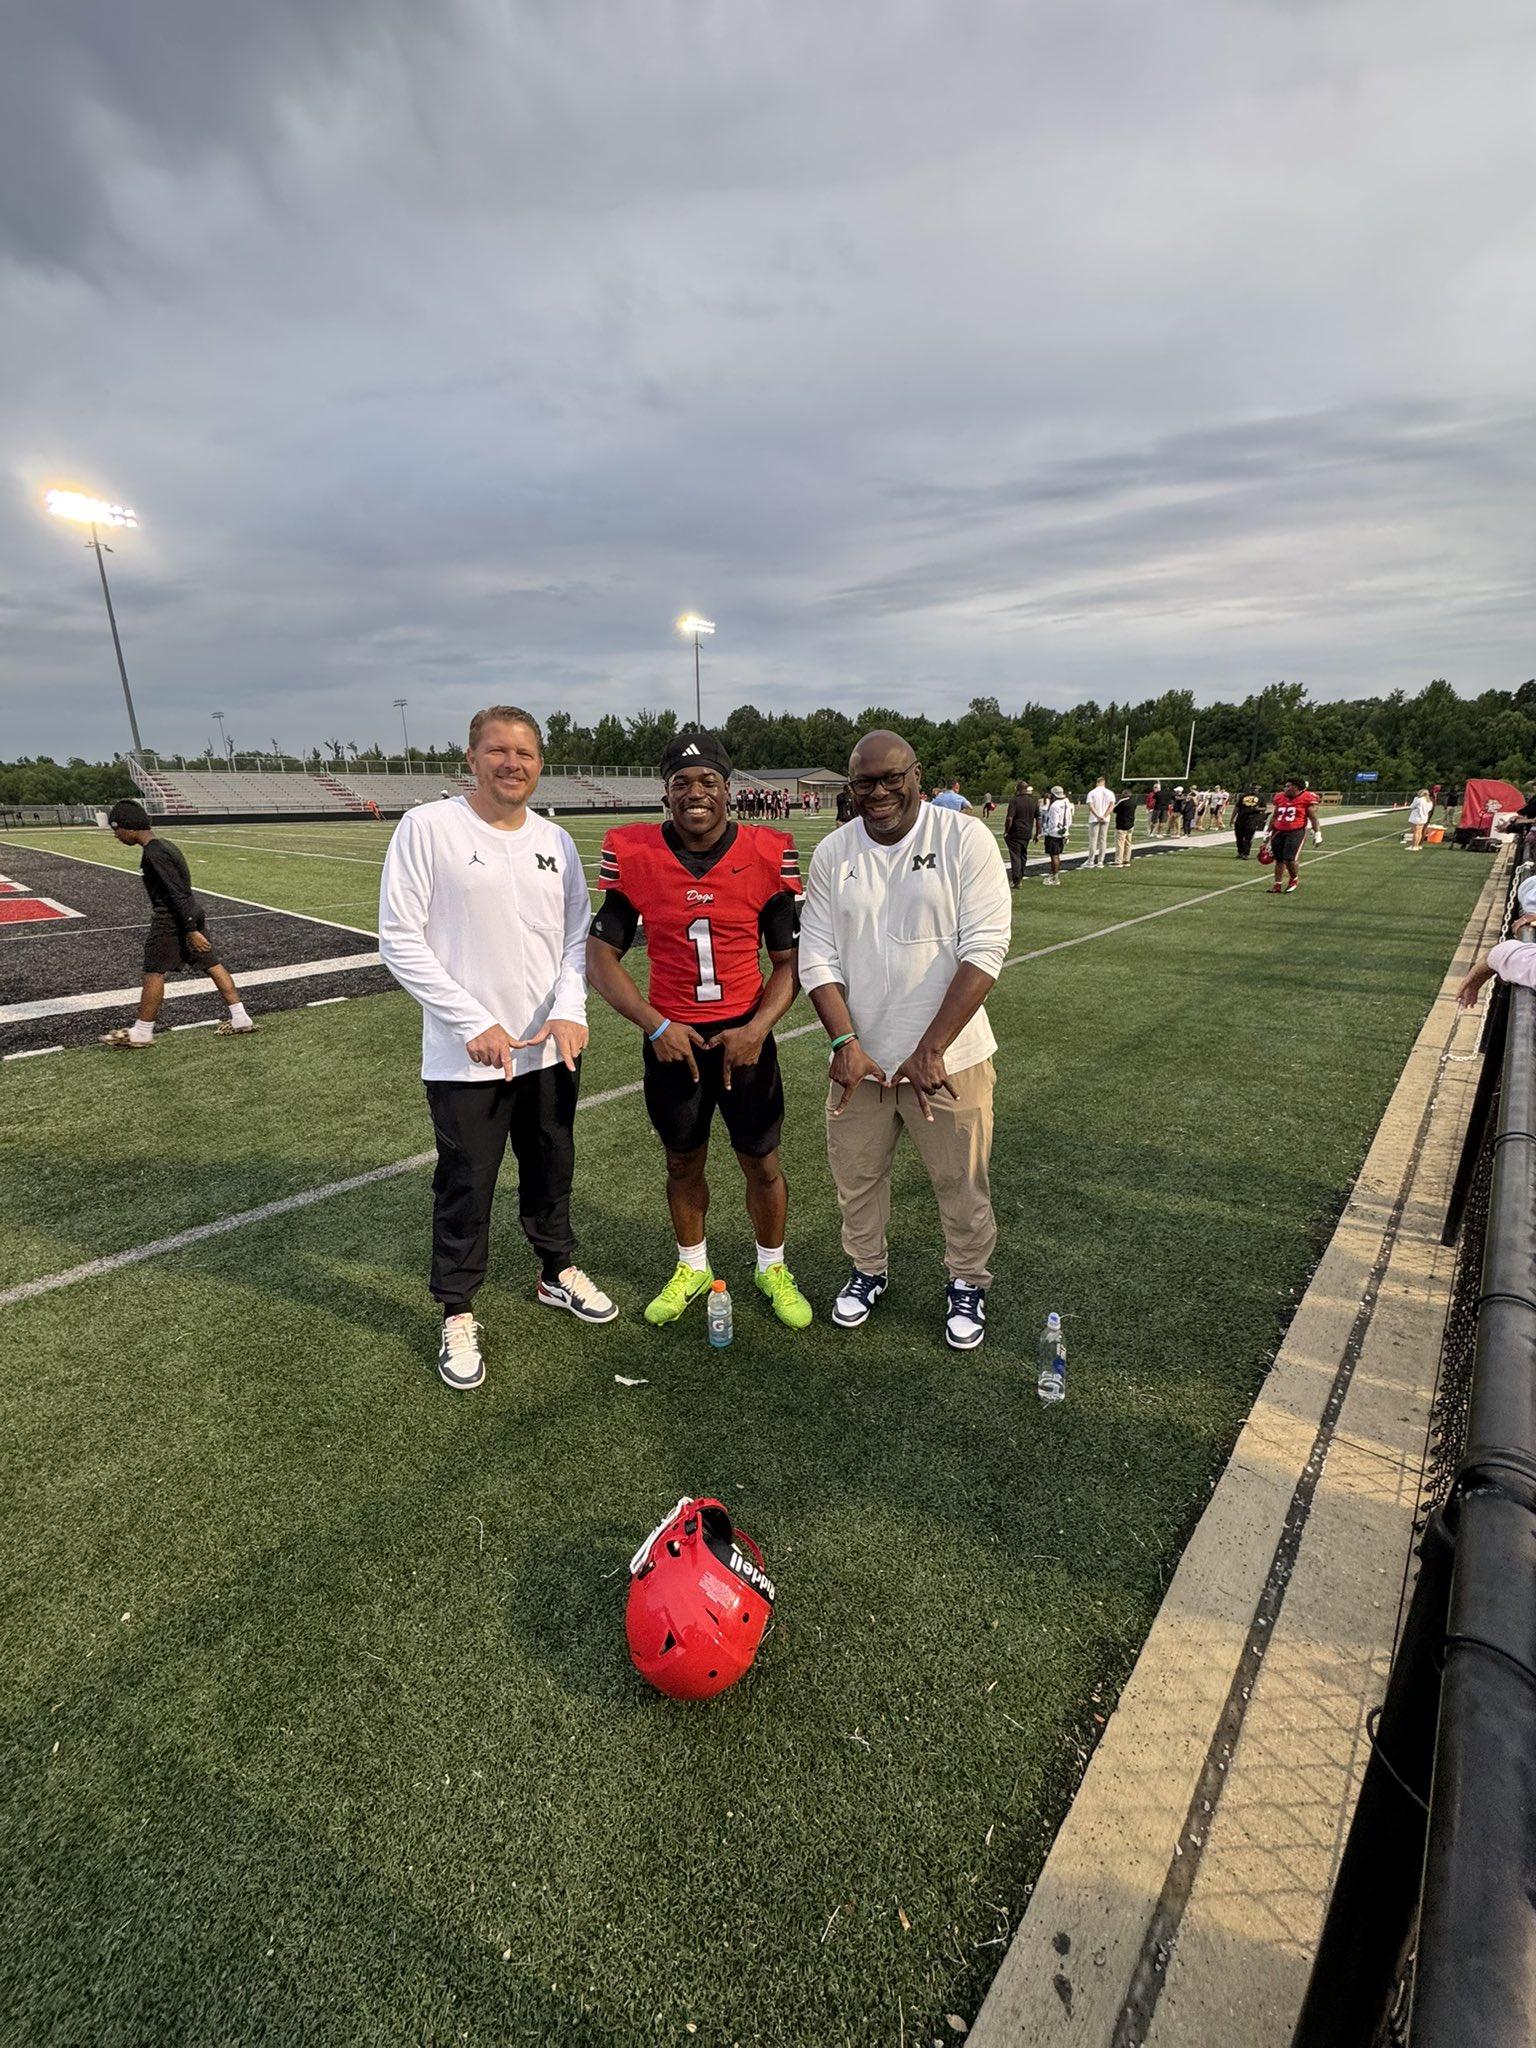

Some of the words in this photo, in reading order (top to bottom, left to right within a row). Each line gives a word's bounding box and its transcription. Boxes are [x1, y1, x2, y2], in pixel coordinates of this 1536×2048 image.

[1276, 806, 1297, 822] 73
[535, 853, 559, 873] M
[912, 853, 937, 872] M
[686, 889, 715, 903] Dogs
[687, 917, 723, 1002] 1
[712, 1319, 725, 1332] G
